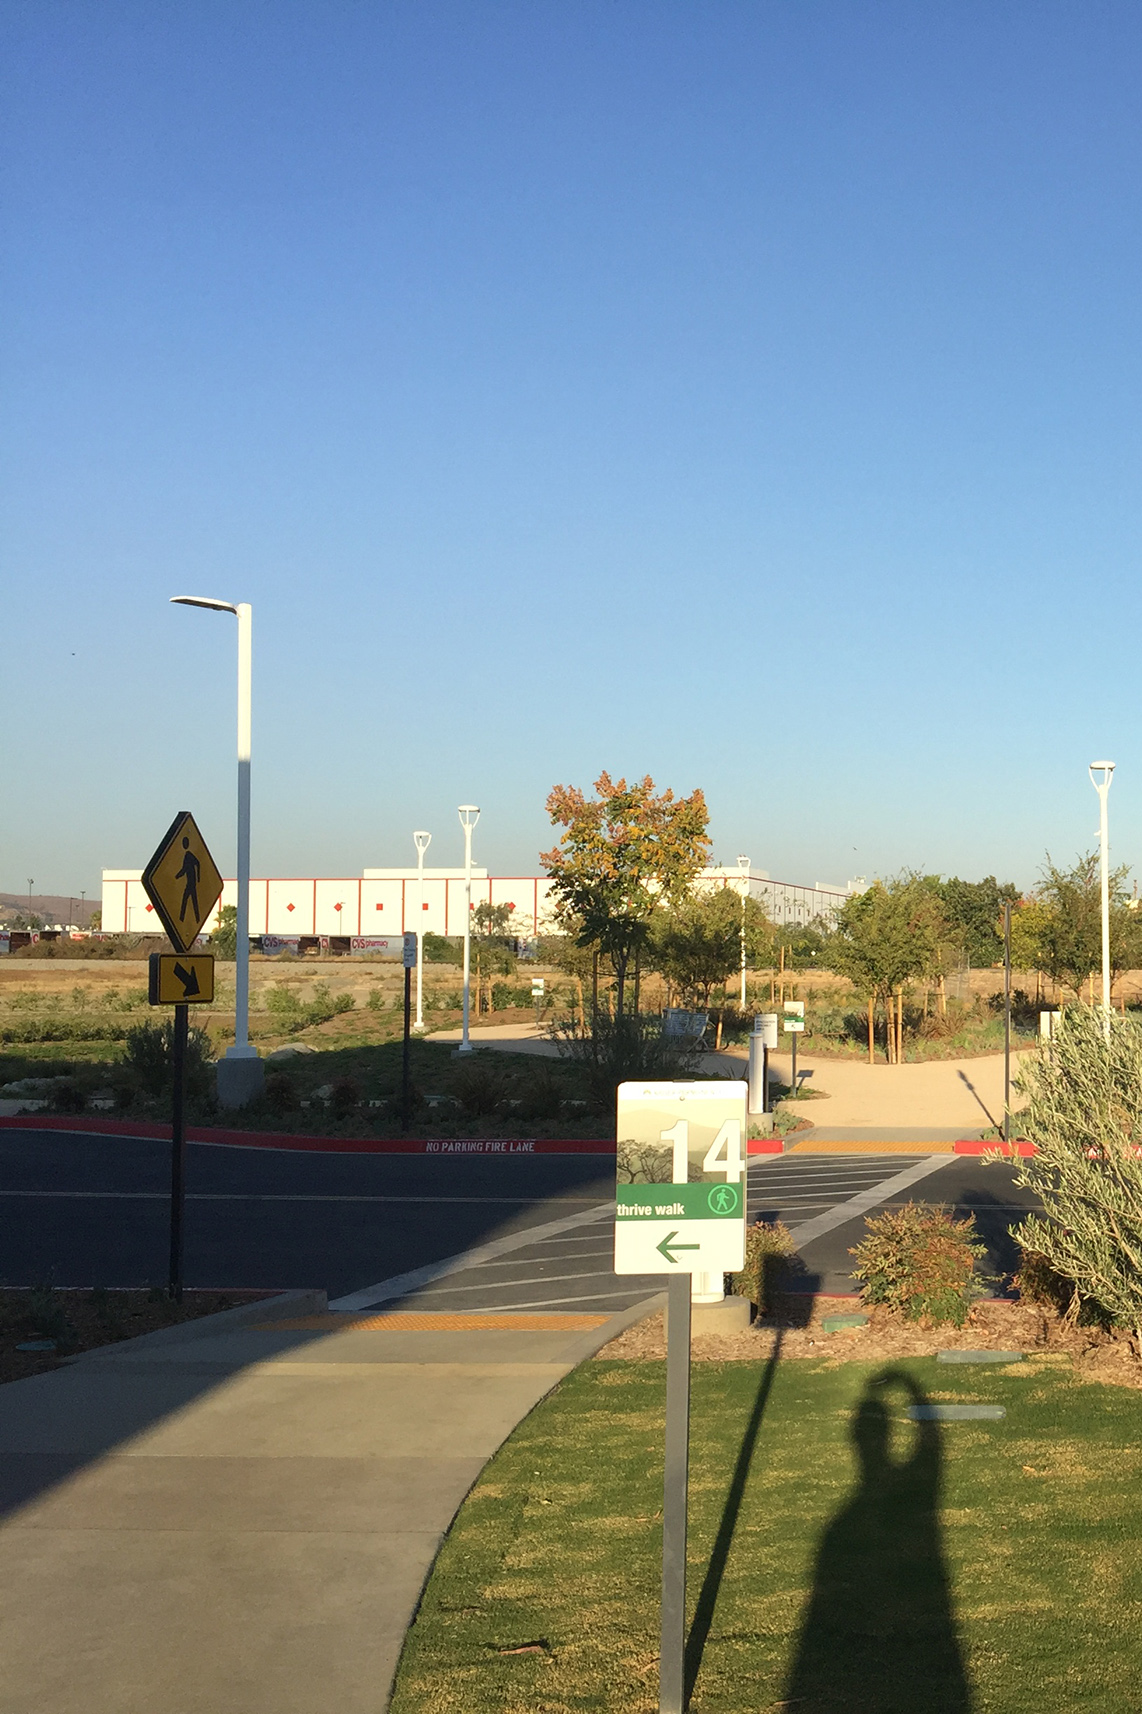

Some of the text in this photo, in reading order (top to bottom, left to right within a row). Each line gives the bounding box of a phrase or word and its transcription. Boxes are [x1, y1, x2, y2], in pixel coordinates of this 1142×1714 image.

[264, 937, 278, 948] CVS
[352, 938, 388, 949] CVS pharmacy
[426, 1142, 535, 1152] NO PARKING FIRE LANE
[660, 1119, 745, 1184] 14
[617, 1203, 685, 1216] thrive walk
